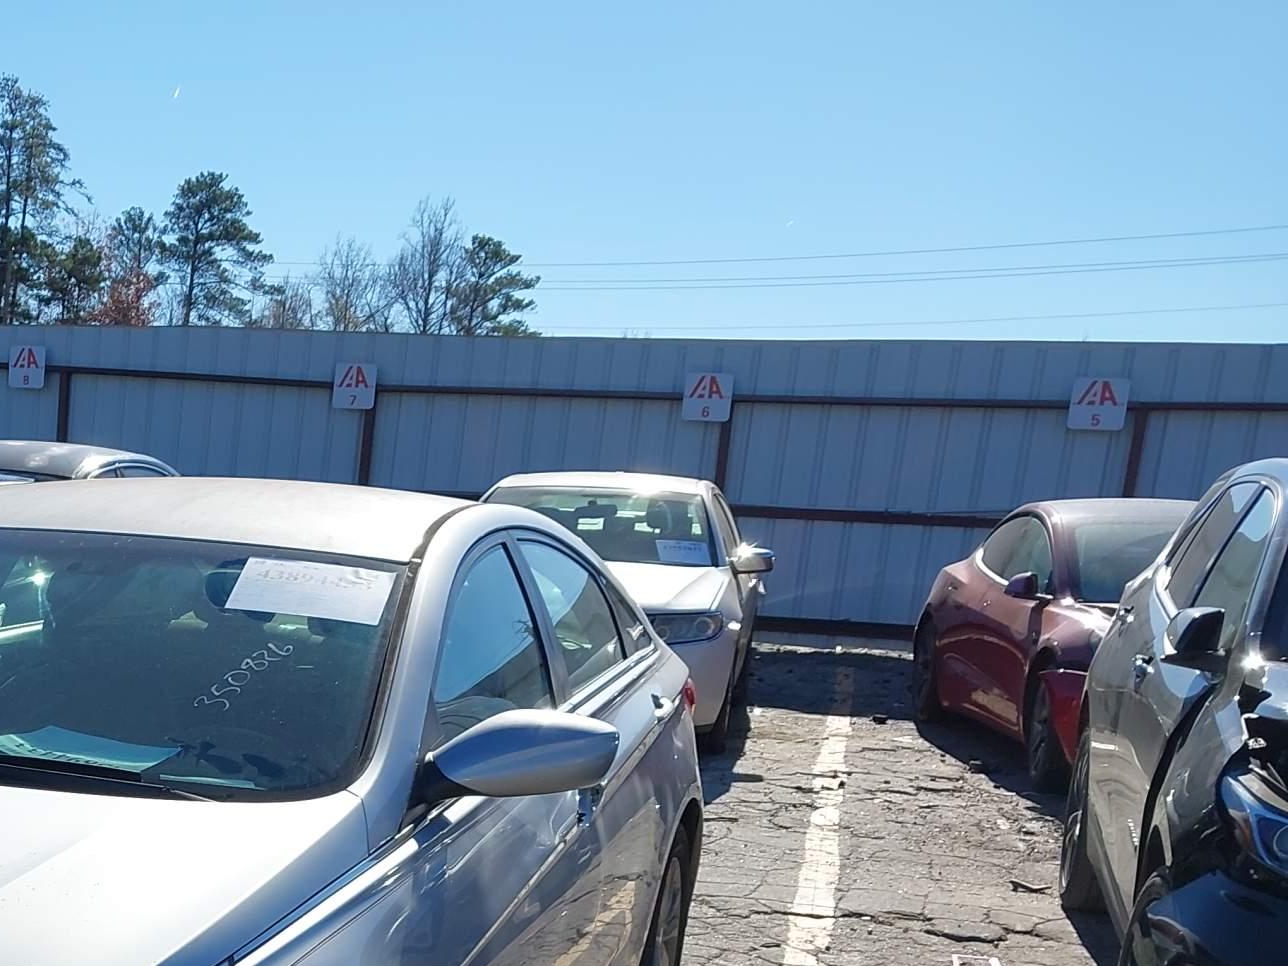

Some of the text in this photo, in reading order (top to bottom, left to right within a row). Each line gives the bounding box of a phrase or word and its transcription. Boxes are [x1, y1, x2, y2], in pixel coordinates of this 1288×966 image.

[23, 375, 30, 386] 8
[349, 395, 357, 406] 7
[701, 405, 710, 418] 6
[1090, 415, 1101, 427] 5
